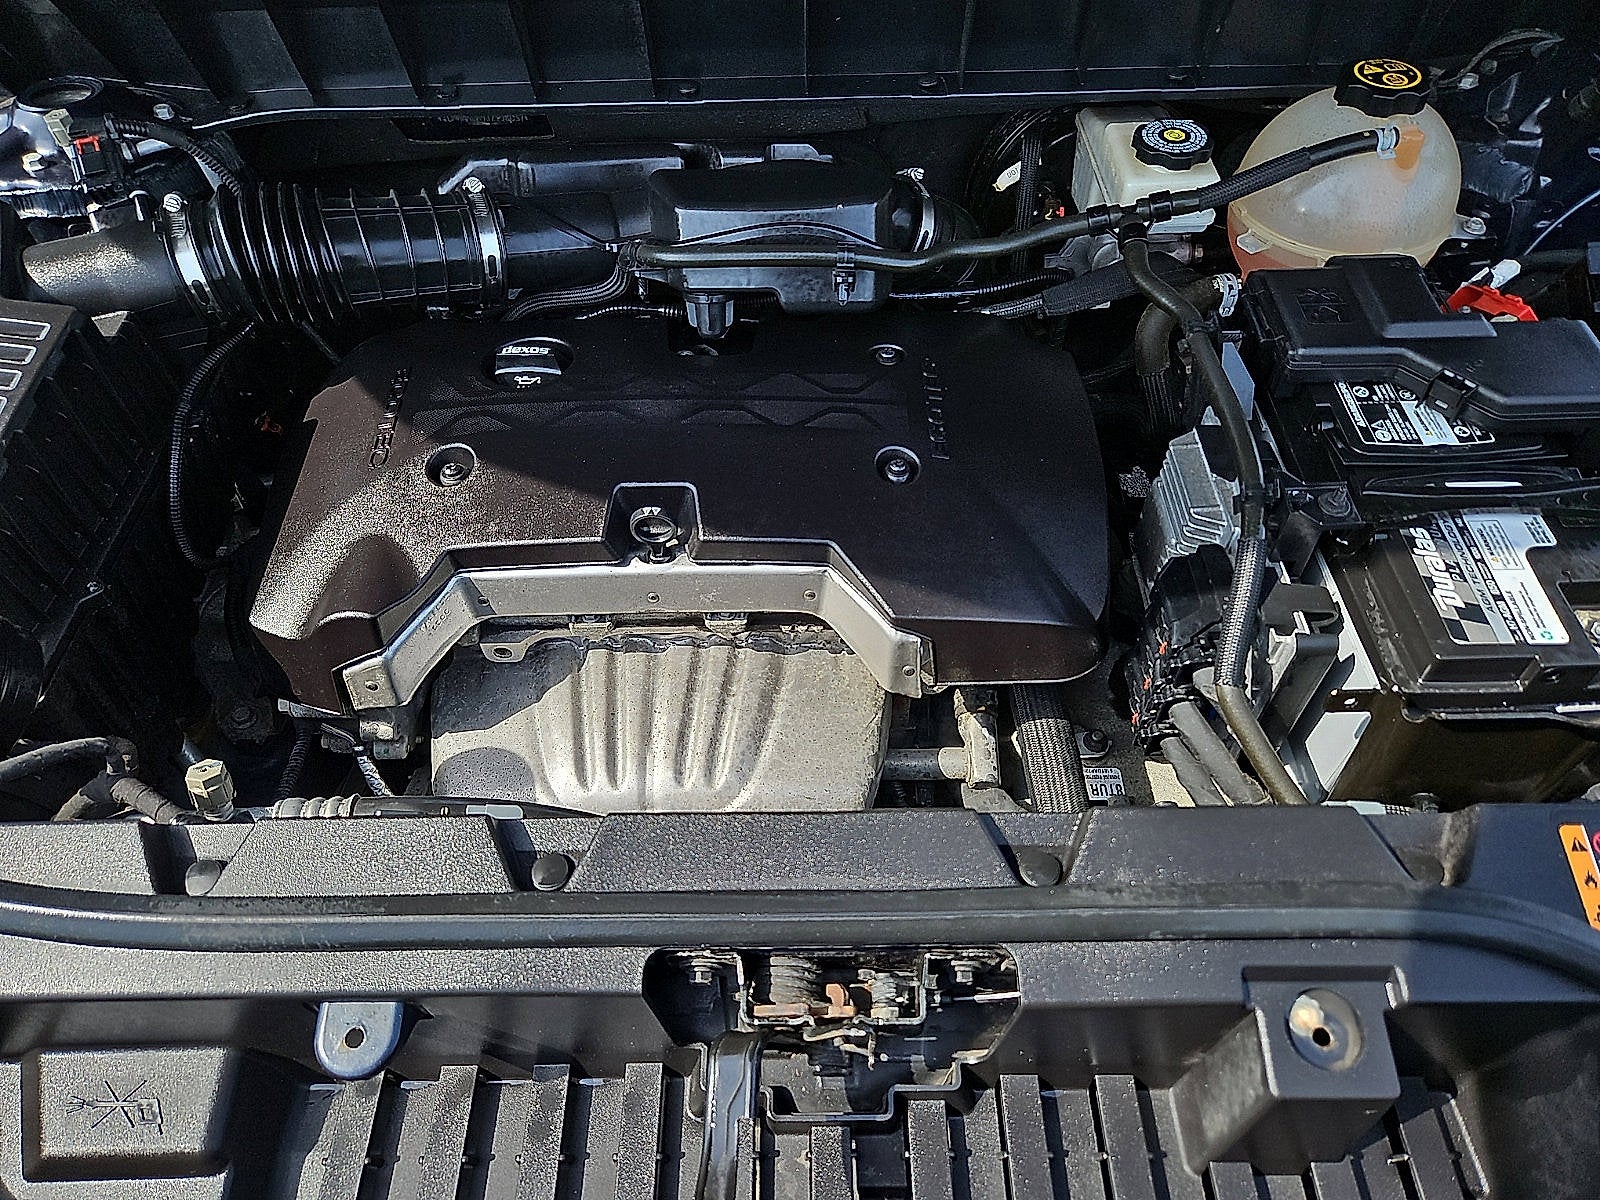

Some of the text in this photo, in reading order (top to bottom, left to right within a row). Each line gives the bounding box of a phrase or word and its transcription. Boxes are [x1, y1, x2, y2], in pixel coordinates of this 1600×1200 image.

[501, 345, 551, 355] dexos
[1403, 514, 1466, 611] Duralas
[1442, 516, 1481, 585] TECHNOLOGY
[1476, 588, 1496, 614] AGM
[1090, 783, 1123, 797] 8TUR
